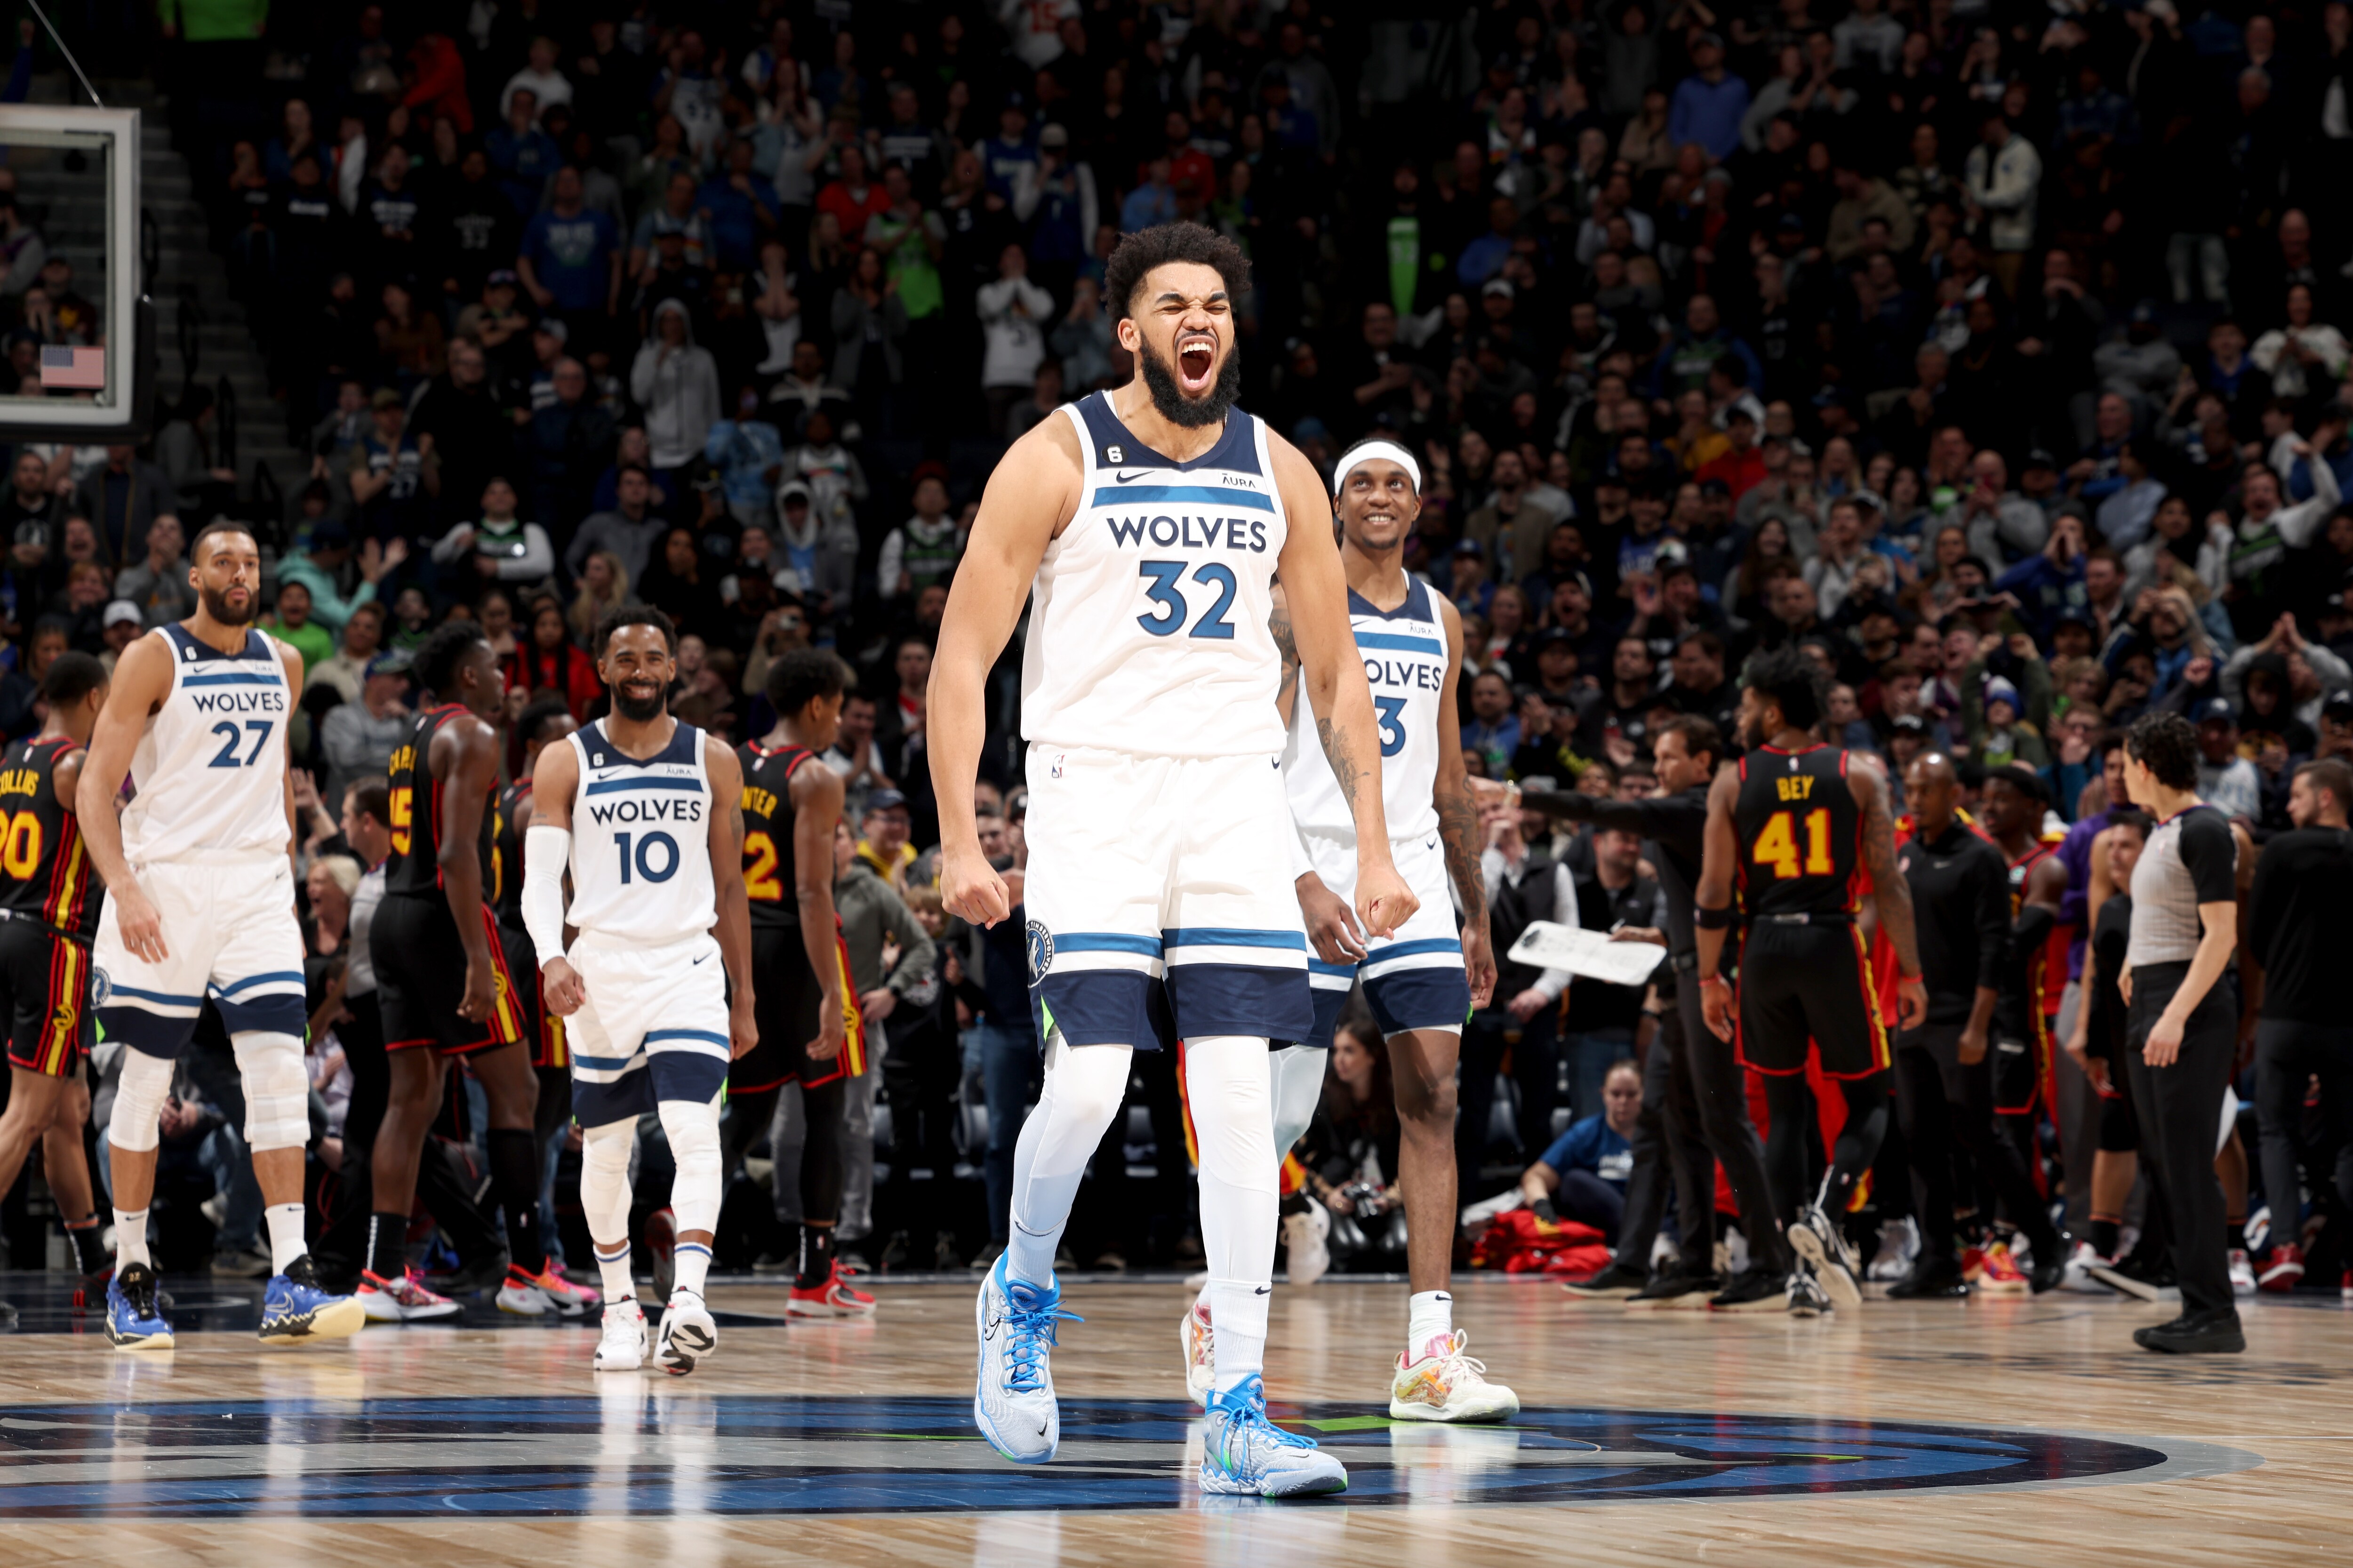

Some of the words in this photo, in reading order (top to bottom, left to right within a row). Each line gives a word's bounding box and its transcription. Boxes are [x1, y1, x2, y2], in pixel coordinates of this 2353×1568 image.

[1107, 447, 1123, 463] 6
[1106, 516, 1266, 553] WOLVES
[1136, 560, 1237, 640] 32
[1364, 659, 1441, 692] OLVES
[192, 693, 284, 712] WOLVES
[208, 720, 273, 767] 27
[1375, 696, 1408, 757] 3
[593, 752, 605, 767] 6
[0, 768, 40, 798] OLLINS
[1776, 775, 1816, 803] BEY
[590, 799, 702, 826] WOLVES
[741, 785, 778, 820] NTER
[614, 831, 680, 884] 10
[1752, 805, 1835, 880] 41
[742, 830, 784, 902] 2
[1031, 921, 1052, 973] TIMBERWOLVES
